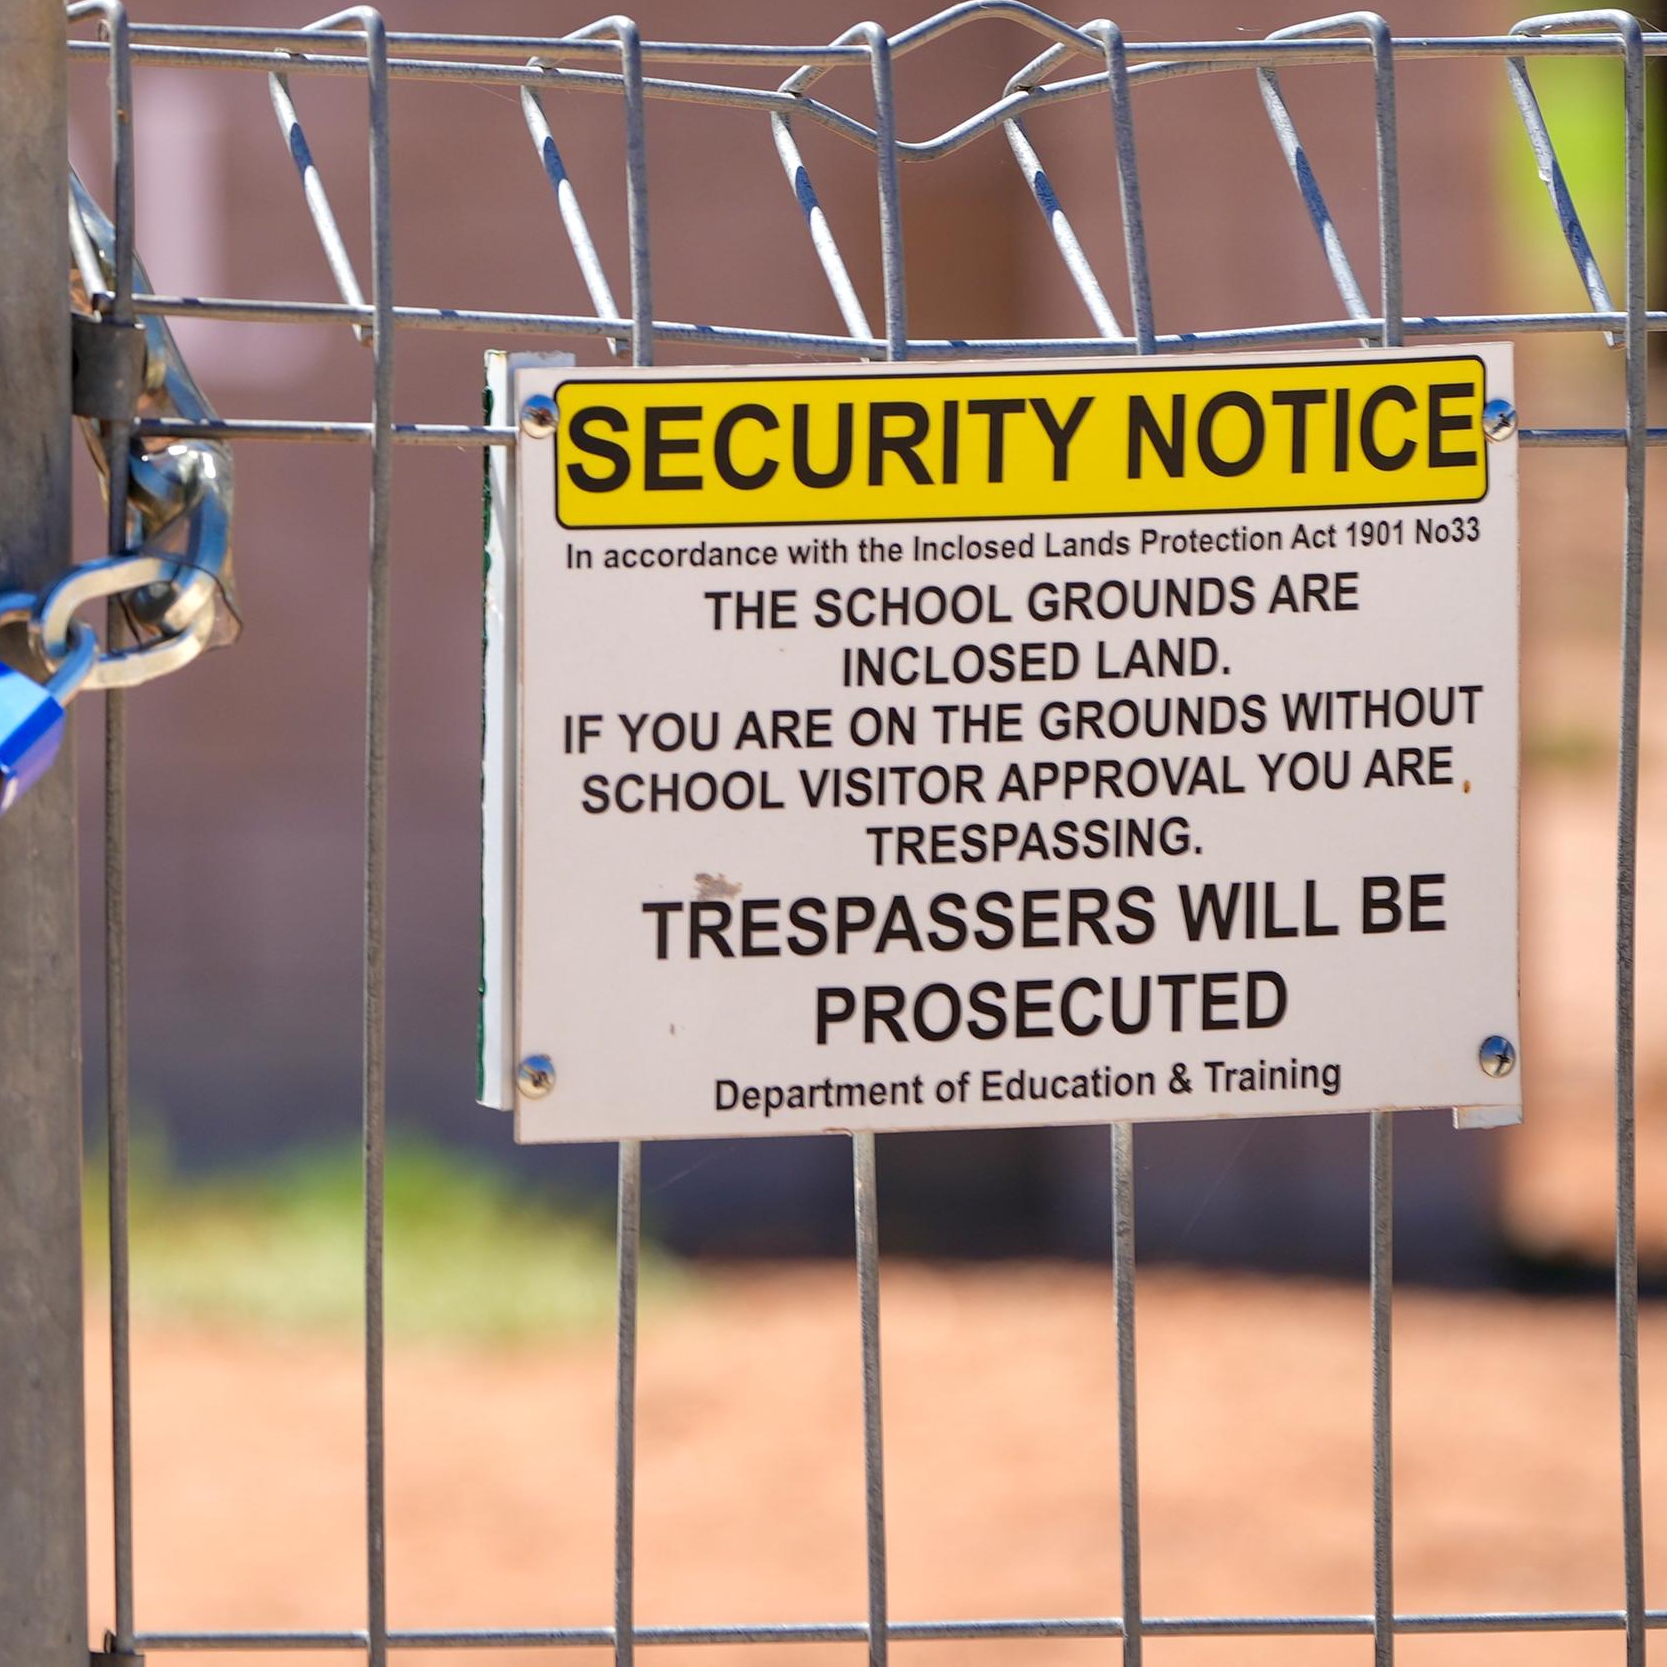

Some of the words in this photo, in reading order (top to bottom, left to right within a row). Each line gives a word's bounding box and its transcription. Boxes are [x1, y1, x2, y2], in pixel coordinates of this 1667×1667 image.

[565, 395, 1095, 494] SECURITY
[1126, 381, 1478, 480] NOTICE
[566, 542, 592, 569] In
[603, 540, 778, 569] accordance
[786, 536, 847, 565] with
[857, 535, 903, 563] the
[913, 531, 1034, 562] Inclosed
[1044, 529, 1130, 558] Lands
[1140, 527, 1282, 555] Protection
[1290, 522, 1336, 550] Act
[1345, 518, 1403, 547] 1901
[1414, 515, 1480, 544] No33
[703, 588, 797, 631] THE
[813, 583, 1012, 629] SCHOOL
[1026, 574, 1255, 622] GROUNDS
[1267, 570, 1359, 614] ARE
[842, 640, 1080, 687] INCLOSED
[1096, 635, 1230, 680] LAND.
[563, 713, 603, 754] IF
[617, 710, 719, 753] YOU
[733, 707, 833, 750] ARE
[848, 705, 916, 747] ON
[931, 701, 1023, 744] THE
[1038, 692, 1267, 741] GROUNDS
[1280, 683, 1484, 732] WITHOUT
[580, 769, 785, 815] SCHOOL
[797, 763, 986, 808] VISITOR
[996, 754, 1246, 802] APPROVAL
[1256, 749, 1350, 792] YOU
[1362, 744, 1454, 788] ARE
[865, 815, 1202, 866] TRESPASSING.
[641, 884, 1156, 960] TRESPASSERS
[1177, 878, 1340, 942] WILL
[1361, 872, 1446, 935] BE
[815, 969, 1288, 1045] PROSECUTED
[714, 1074, 924, 1118] Department
[934, 1069, 971, 1104] of
[981, 1064, 1155, 1102] Education
[1167, 1061, 1193, 1095] &
[1202, 1056, 1341, 1096] Training
